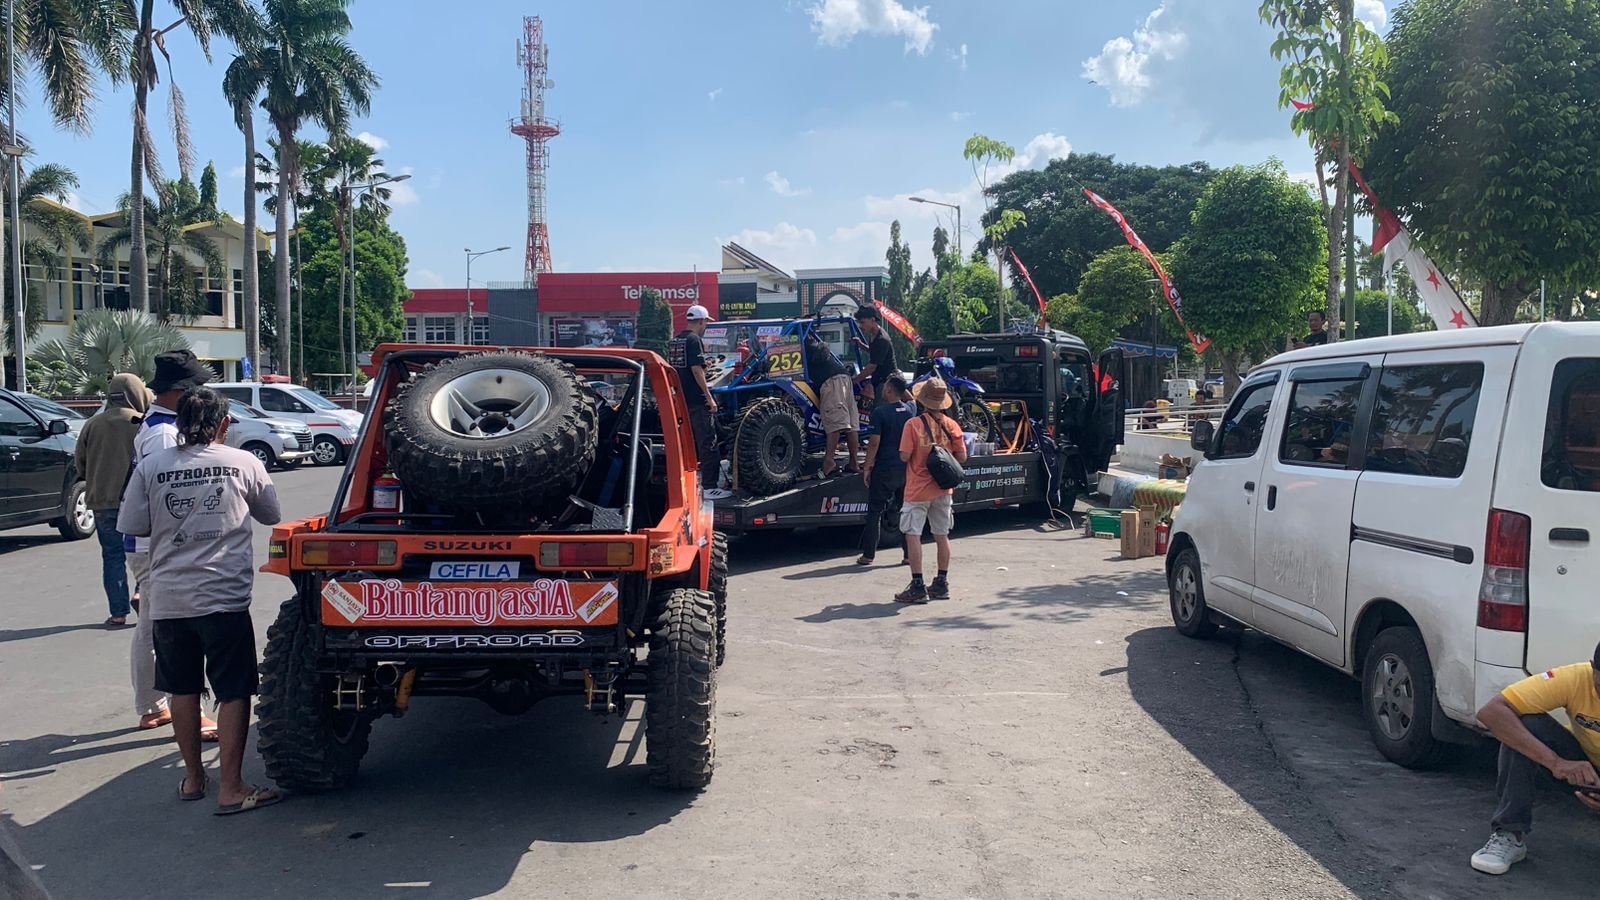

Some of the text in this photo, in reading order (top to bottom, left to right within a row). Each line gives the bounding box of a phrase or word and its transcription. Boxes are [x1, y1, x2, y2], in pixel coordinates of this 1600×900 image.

[769, 351, 803, 372] 252
[157, 466, 240, 484] OFFROADER
[1002, 464, 1023, 473] service
[170, 480, 209, 488] EXPEDITION
[423, 541, 512, 550] SUZUKI
[437, 564, 511, 578] CEFILA
[360, 579, 497, 626] Bintang
[499, 579, 577, 620] asiA
[364, 633, 585, 649] OFFROAD
